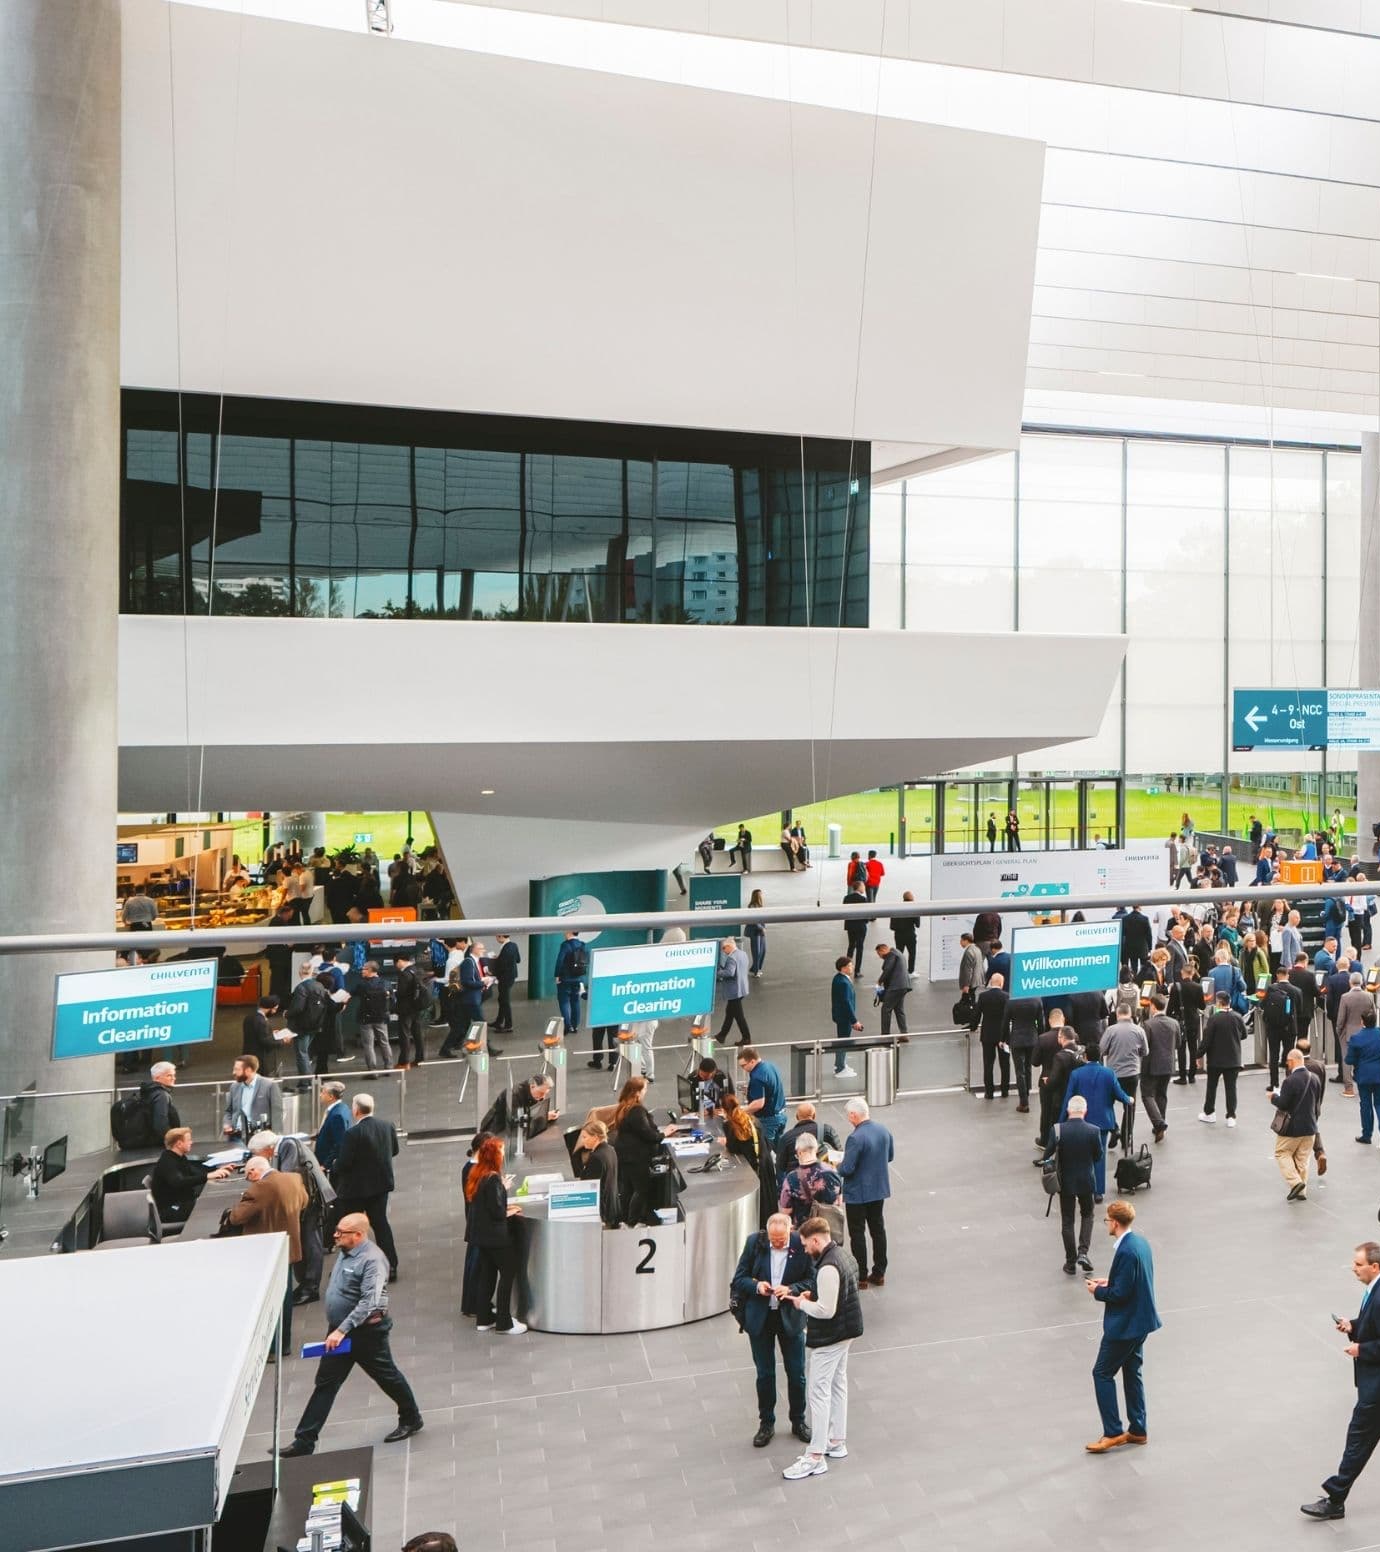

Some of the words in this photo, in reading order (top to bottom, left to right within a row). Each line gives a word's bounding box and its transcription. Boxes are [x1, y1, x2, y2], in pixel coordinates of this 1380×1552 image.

[1271, 704, 1278, 716] 4
[1288, 704, 1295, 716] 9
[1302, 704, 1323, 716] NCC
[1289, 718, 1306, 730] Ost
[1021, 954, 1110, 972] Willkommmen
[611, 976, 695, 997] Information
[1021, 975, 1079, 990] Welcome
[82, 1001, 189, 1025] Information
[623, 998, 682, 1015] Clearing
[98, 1024, 172, 1045] Clearing
[635, 1238, 657, 1274] 2
